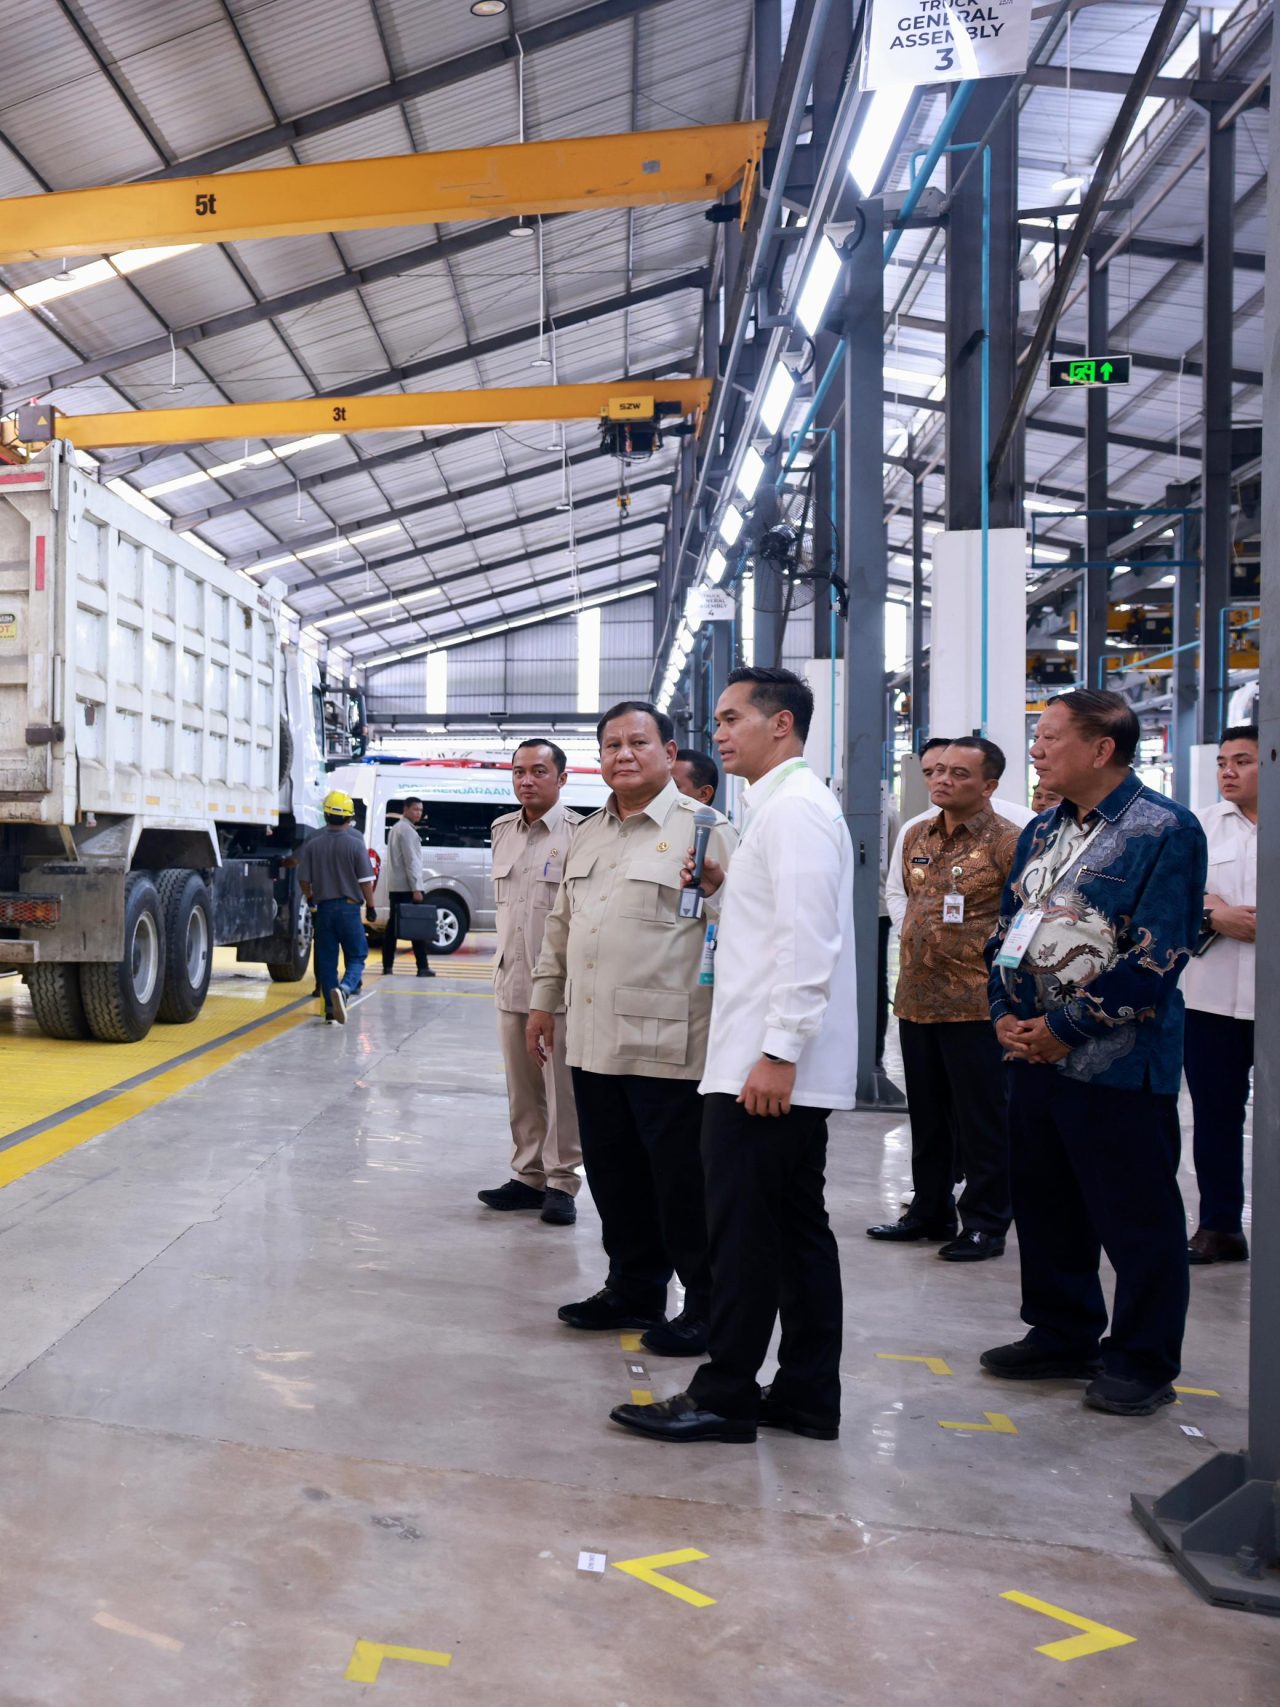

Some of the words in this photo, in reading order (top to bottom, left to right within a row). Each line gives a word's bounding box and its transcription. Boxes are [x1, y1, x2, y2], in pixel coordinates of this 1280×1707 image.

[897, 7, 999, 31] GENERAL
[934, 48, 954, 71] 3
[195, 194, 216, 216] 5t
[333, 407, 346, 421] 3t
